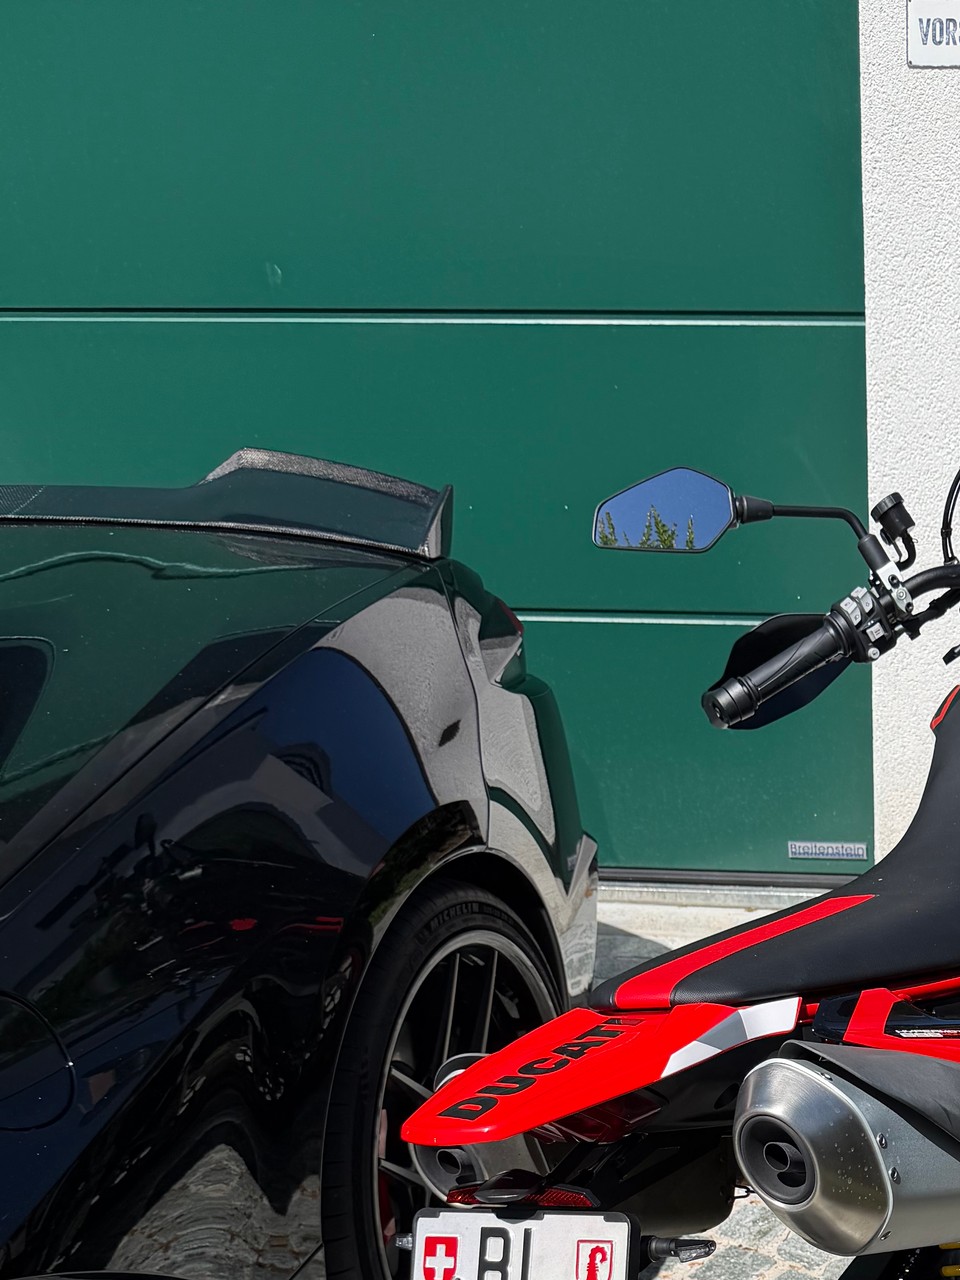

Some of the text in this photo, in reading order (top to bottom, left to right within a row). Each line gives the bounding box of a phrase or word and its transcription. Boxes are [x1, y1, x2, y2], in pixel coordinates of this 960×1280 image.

[790, 843, 865, 855] Breitenstein
[429, 902, 480, 930] MICHELIN
[437, 1018, 646, 1121] DUCATI
